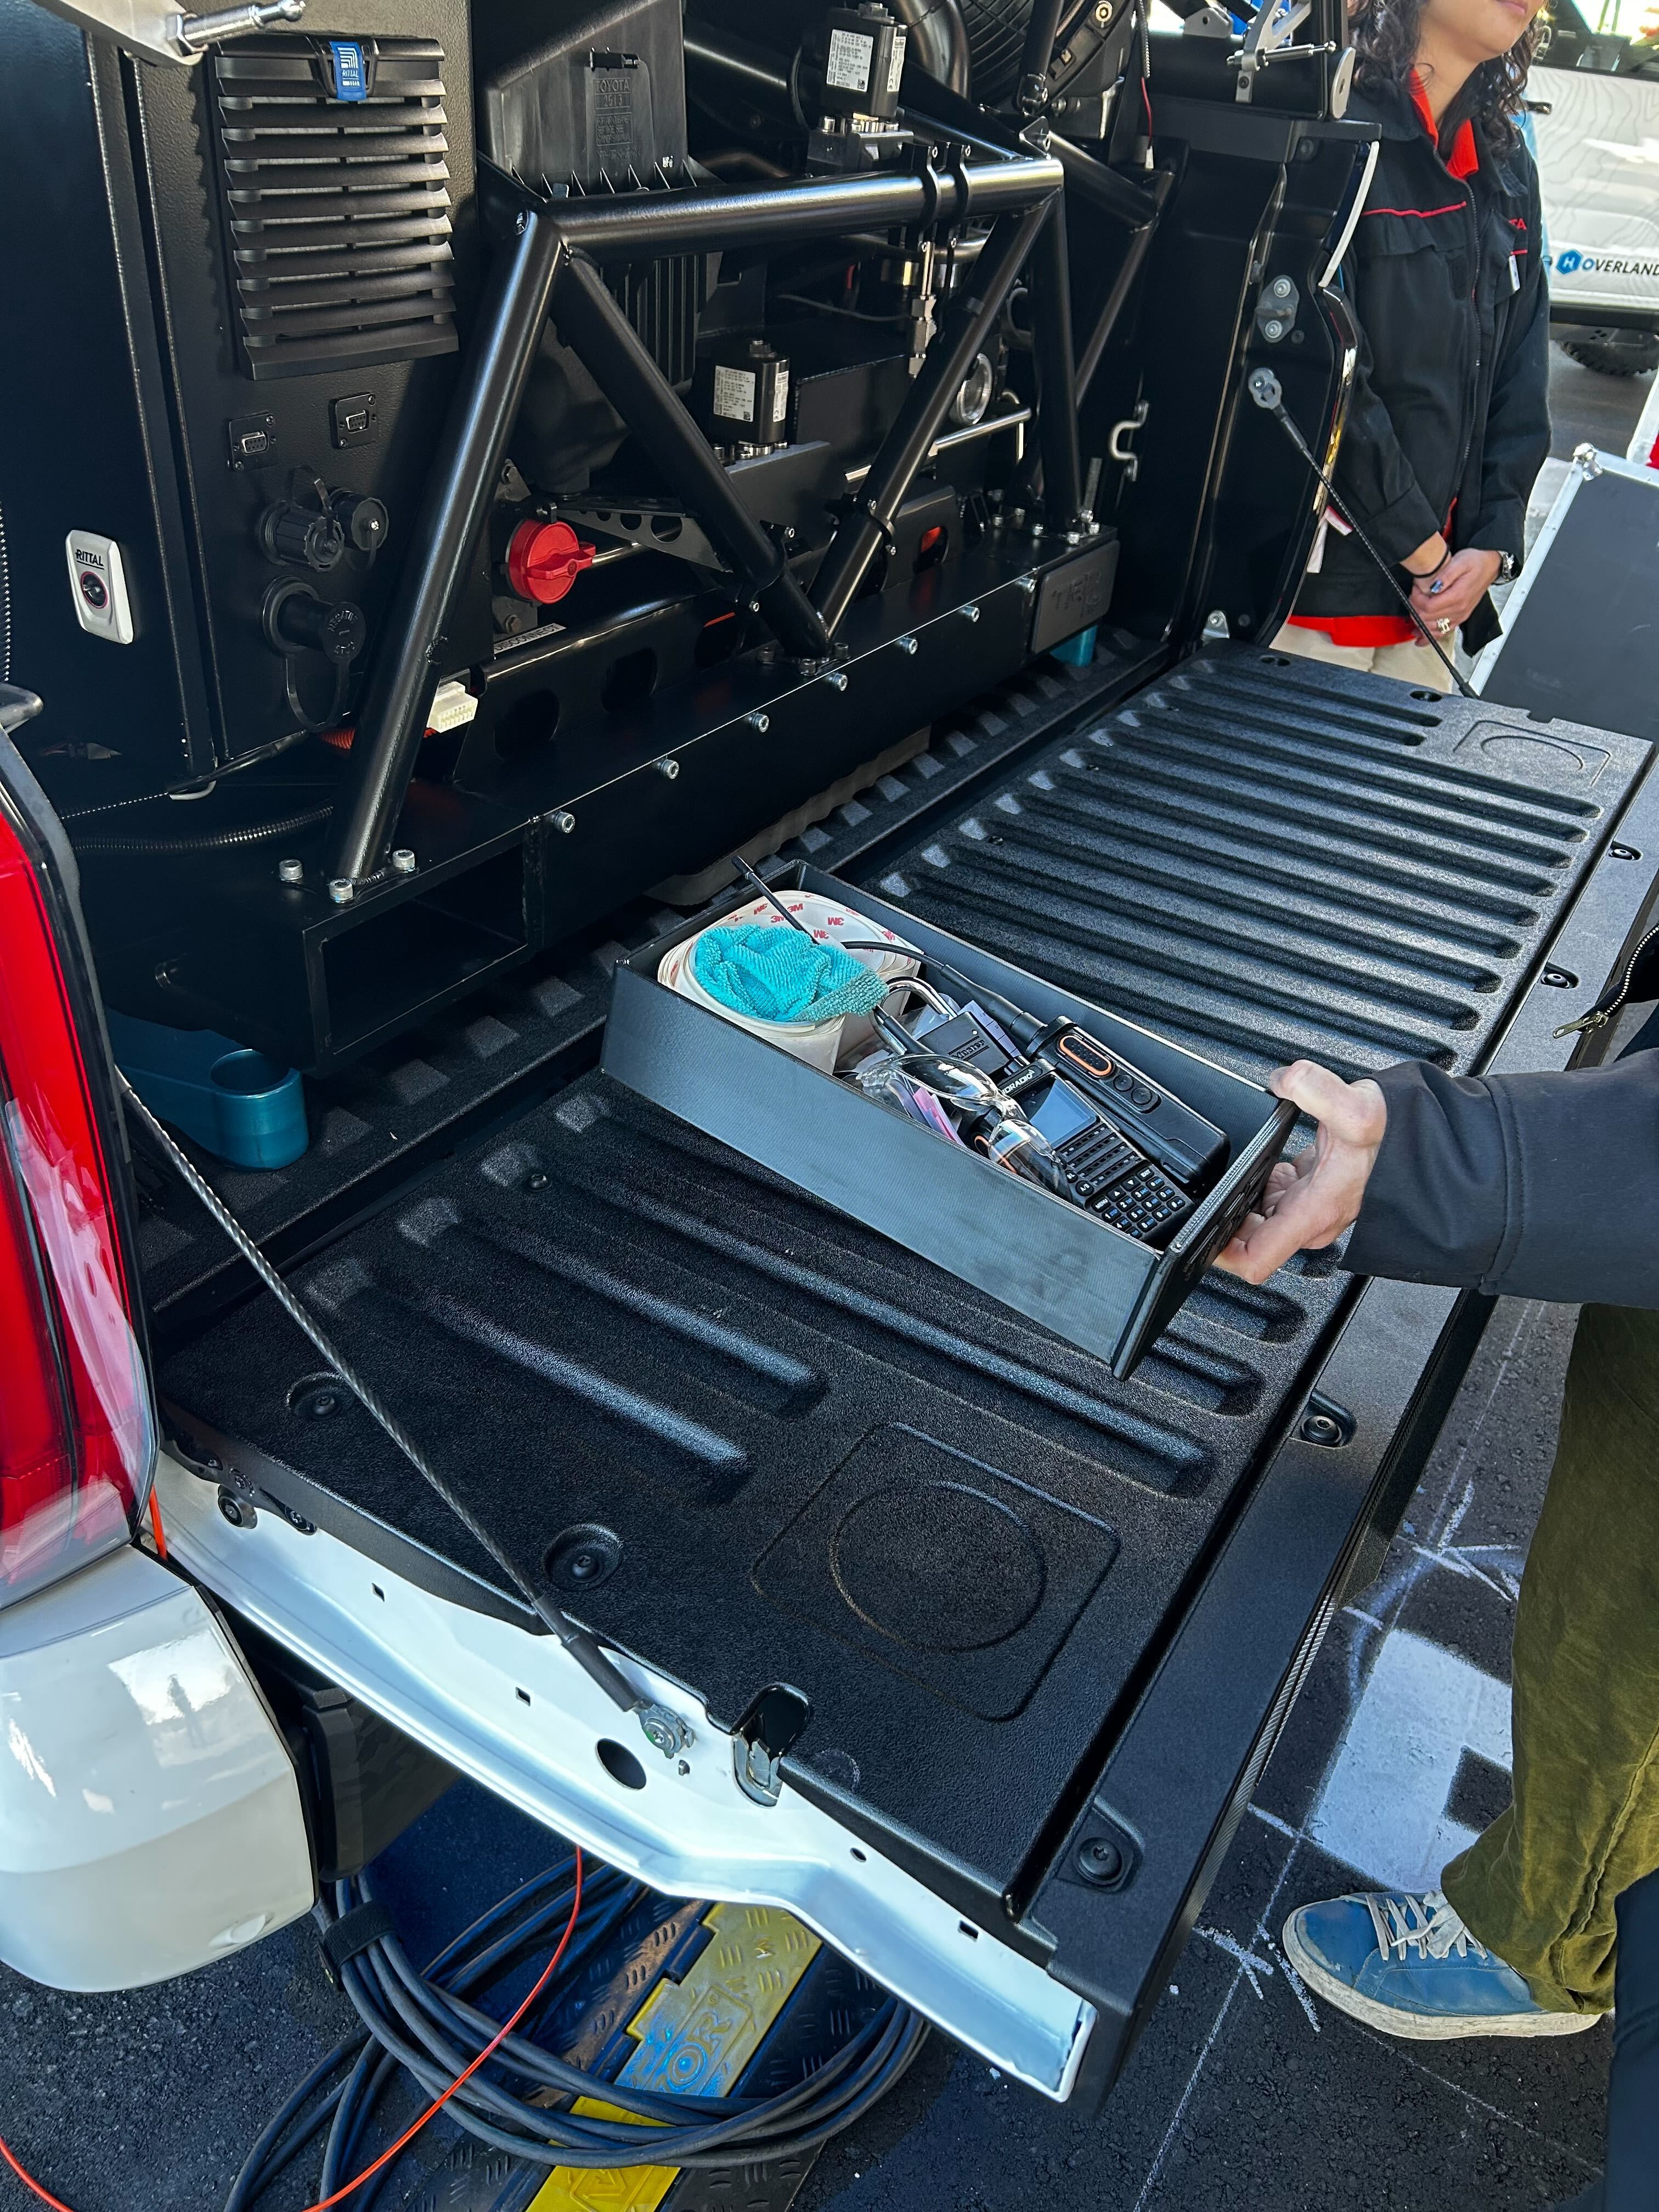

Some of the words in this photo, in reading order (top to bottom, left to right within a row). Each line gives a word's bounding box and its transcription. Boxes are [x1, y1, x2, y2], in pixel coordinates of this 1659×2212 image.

[595, 78, 630, 93] TOYOTA
[75, 549, 104, 566] RITTAL
[754, 903, 768, 915] 3M
[787, 903, 803, 912] 3M
[827, 917, 844, 926] 3M
[813, 929, 829, 939] 3M
[1002, 1073, 1033, 1093] IDRADIO
[1141, 1169, 1151, 1177] EXIT
[1095, 1198, 1108, 1209] MENU
